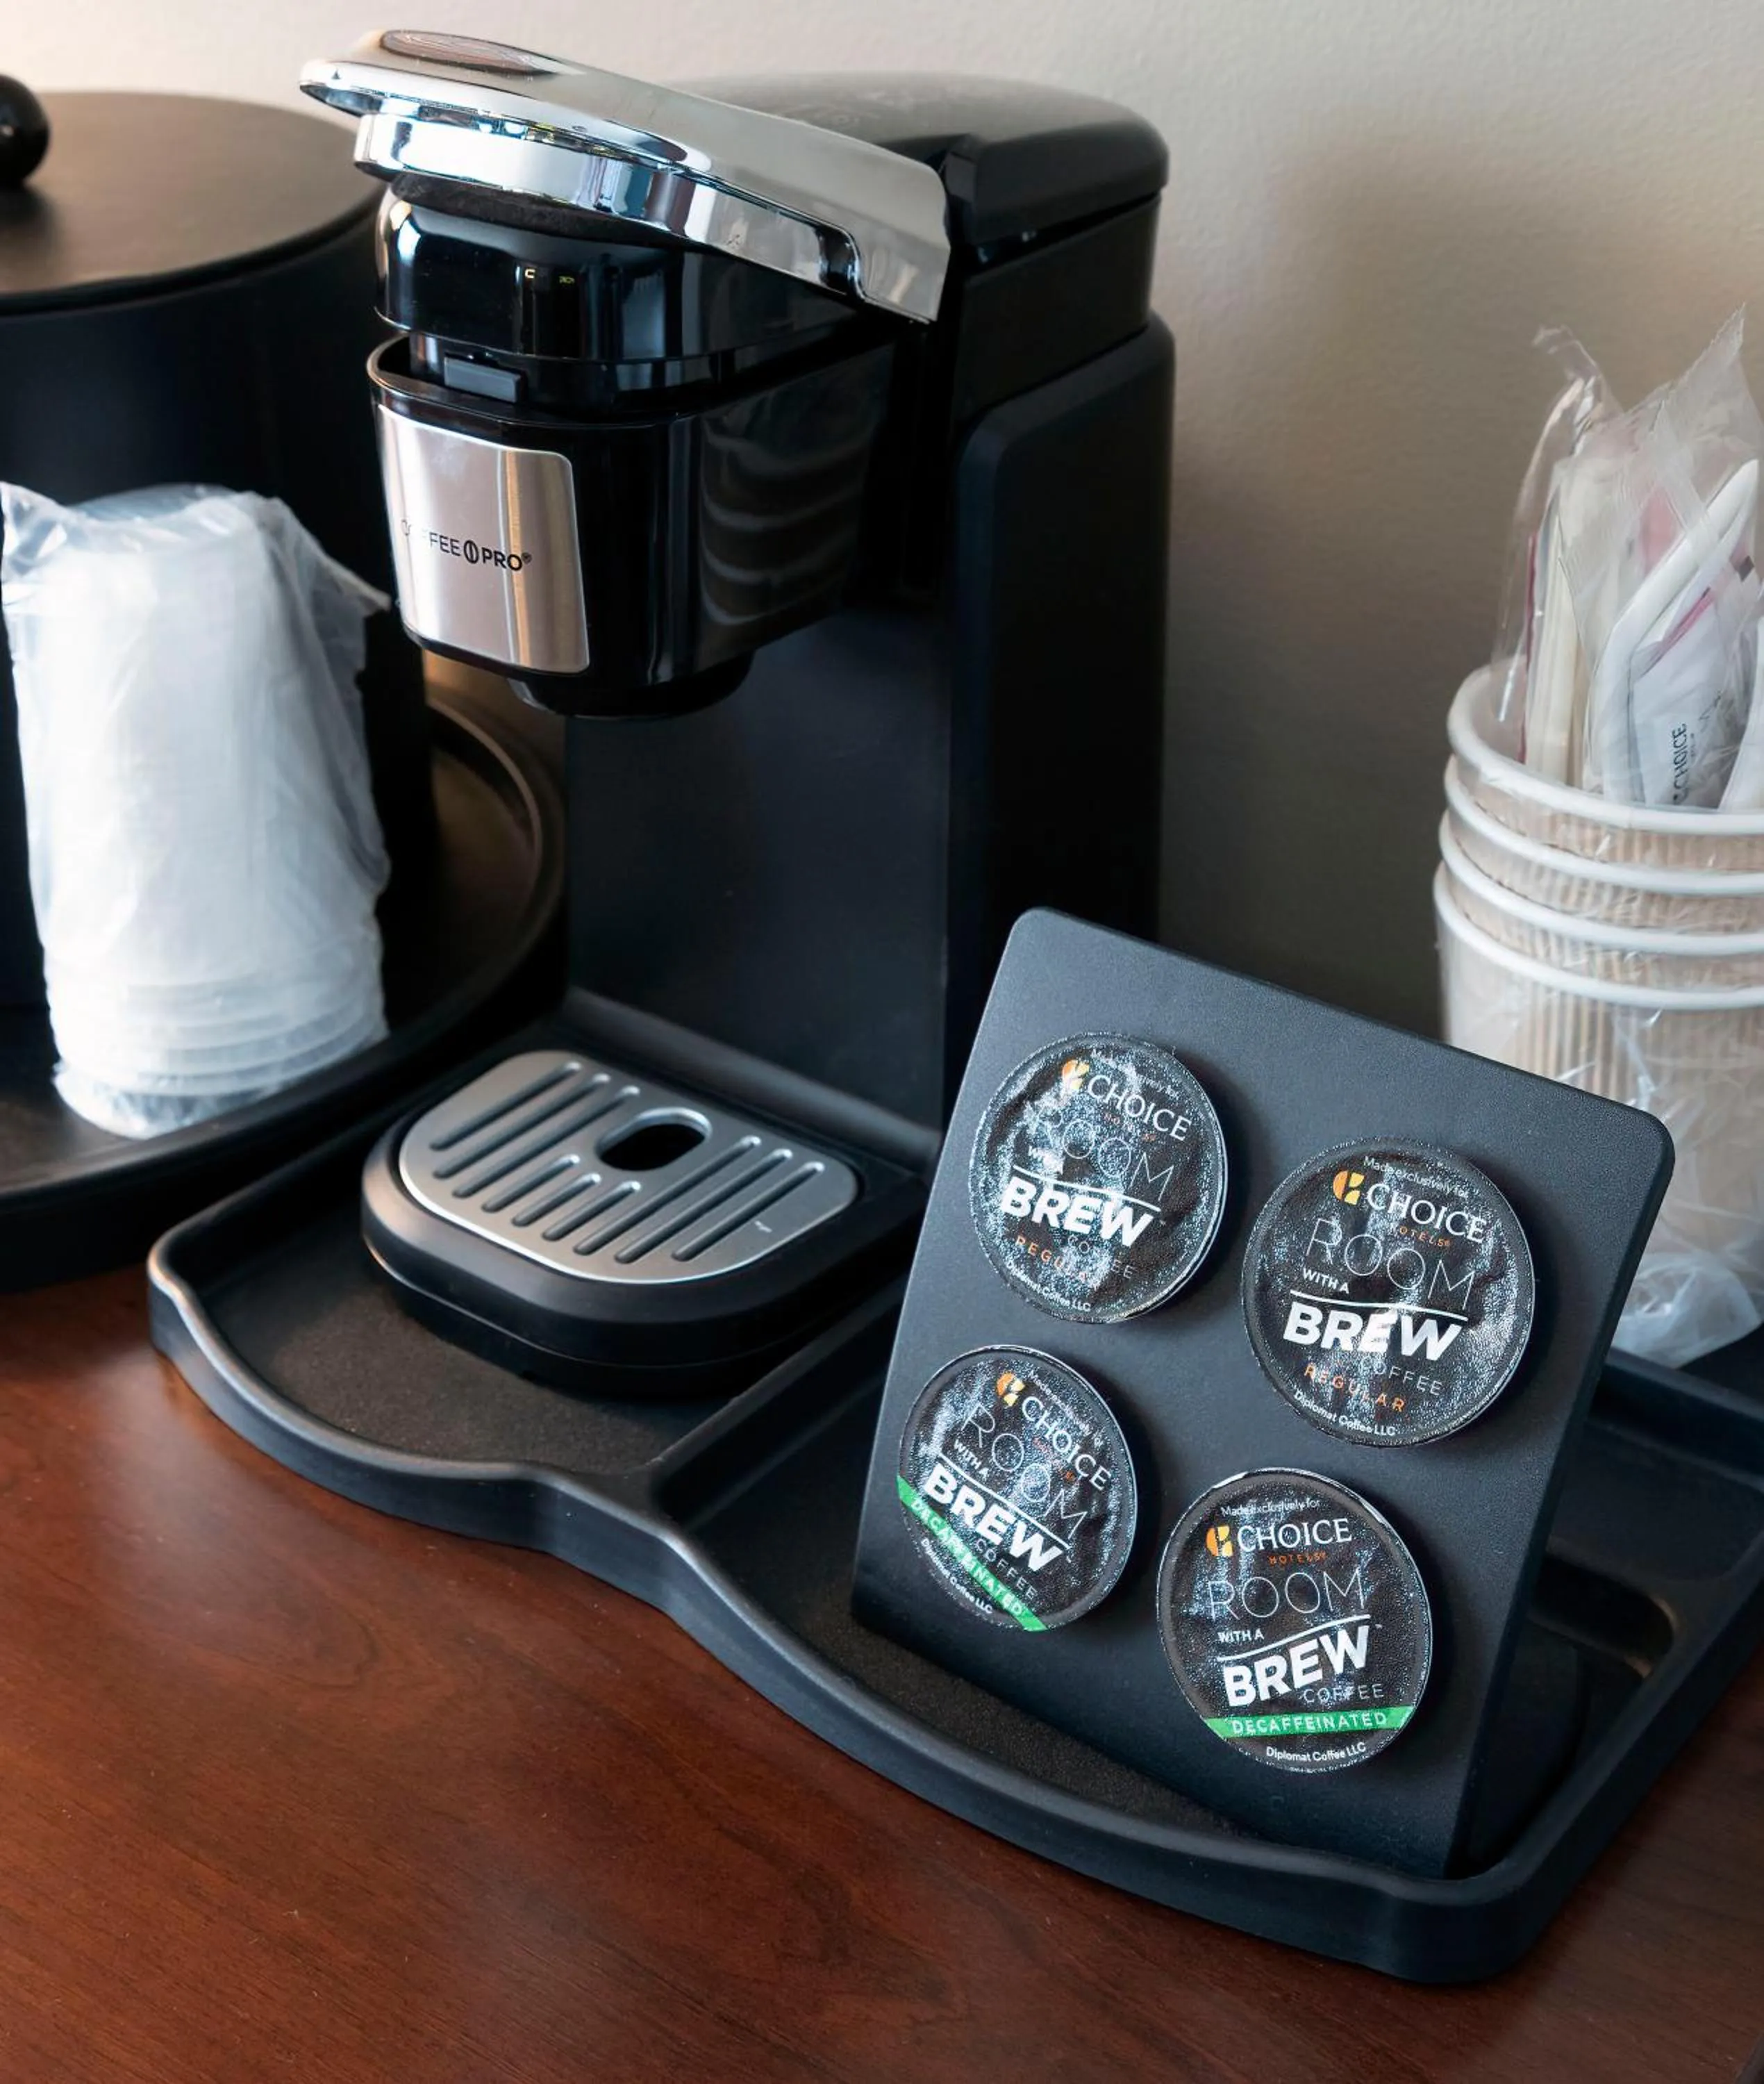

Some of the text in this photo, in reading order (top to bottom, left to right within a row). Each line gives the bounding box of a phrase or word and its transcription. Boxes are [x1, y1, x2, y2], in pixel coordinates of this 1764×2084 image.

[1672, 723, 1688, 789] CHOICE
[1087, 1075, 1192, 1141] CHOICE
[1000, 1177, 1154, 1247] BREW
[1366, 1183, 1488, 1243] CHOICE
[1302, 1268, 1349, 1294] WITH A
[1306, 1218, 1476, 1310] ROOM
[1283, 1301, 1463, 1361] BREW
[954, 1439, 989, 1480] WITH A
[1022, 1396, 1112, 1491] CHOICE
[1374, 1423, 1396, 1436] LLC
[961, 1403, 1088, 1541] ROOM
[924, 1464, 1063, 1572] BREW
[1238, 1518, 1352, 1552] CHOICE
[976, 1539, 1038, 1600] COFFEE
[1207, 1569, 1367, 1621] ROOM
[975, 1598, 993, 1614] LLC
[1217, 1628, 1265, 1644] WITH A
[1222, 1625, 1370, 1707] BREW
[1303, 1683, 1385, 1704] COFFEE
[1231, 1711, 1388, 1735] DECAFFEINATED
[1266, 1746, 1311, 1763] Diplomat
[1312, 1749, 1346, 1762] Coffee
[1346, 1742, 1366, 1756] LLC
